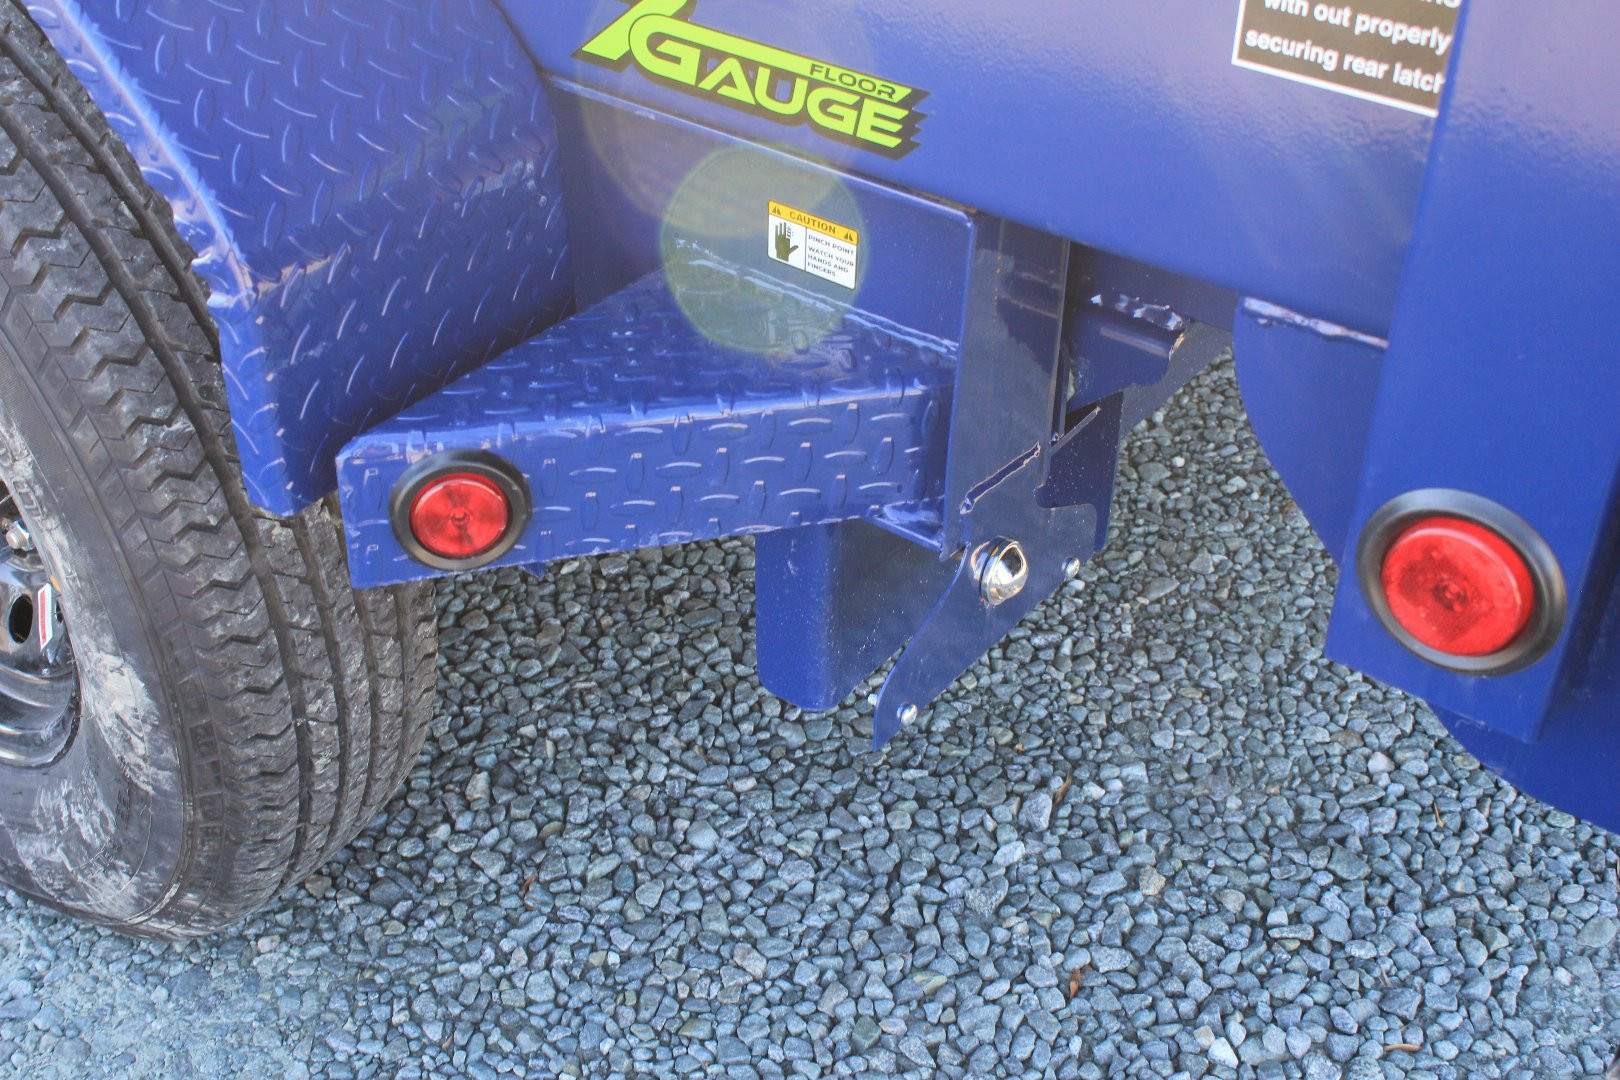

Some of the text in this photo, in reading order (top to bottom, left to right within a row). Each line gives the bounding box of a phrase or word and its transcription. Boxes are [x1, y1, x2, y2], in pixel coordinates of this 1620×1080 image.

[1313, 3, 1352, 28] out
[1354, 13, 1452, 56] properly
[1245, 29, 1339, 72] securing
[1343, 54, 1389, 80] rear
[629, 14, 910, 148] GAUGE
[808, 63, 897, 99] FLOOR
[789, 211, 836, 234] CAUTION
[808, 234, 854, 256] PINCH POINT
[808, 246, 854, 267] WATCH YOUR
[807, 254, 849, 273] HANDS AND
[807, 262, 836, 277] FINGERS
